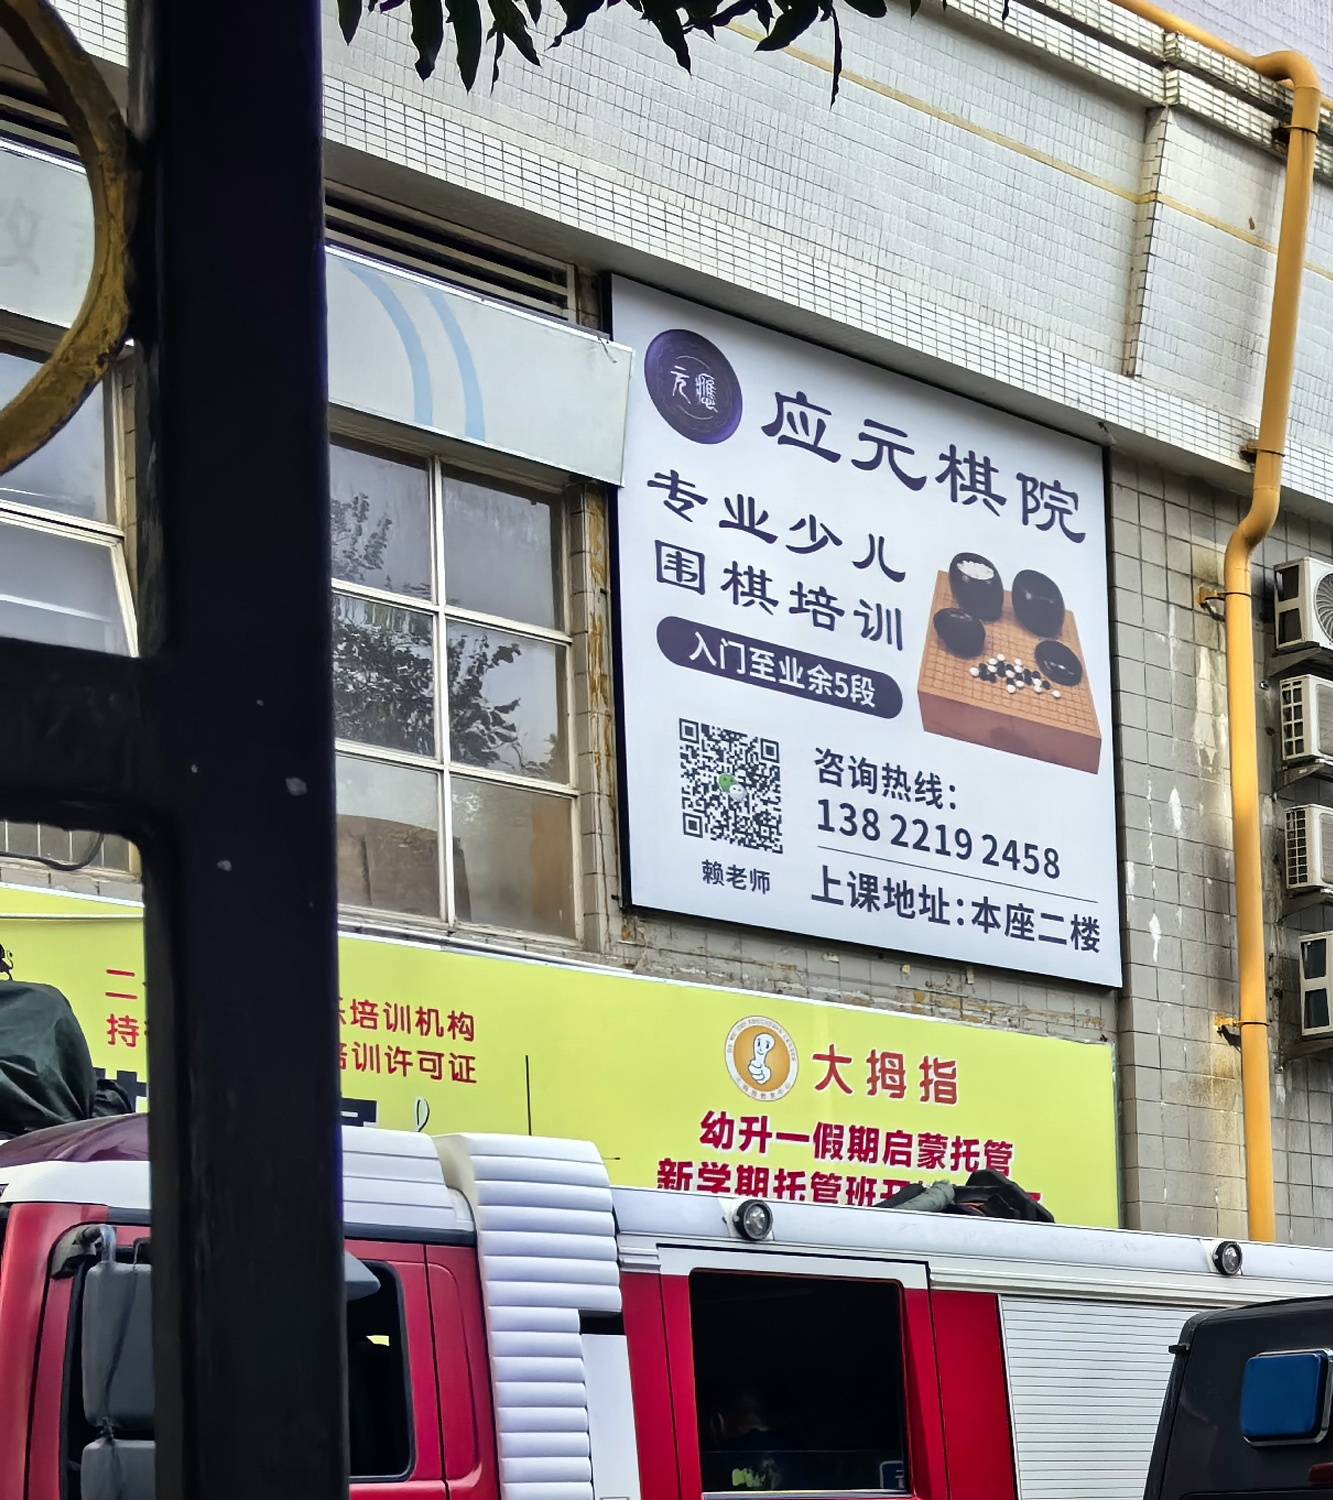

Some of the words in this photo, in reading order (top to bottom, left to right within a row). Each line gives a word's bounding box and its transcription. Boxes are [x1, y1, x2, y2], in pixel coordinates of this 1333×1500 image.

[761, 391, 1086, 543] 应元棋院
[646, 470, 907, 583] 专业少儿
[654, 540, 904, 651] 围棋培训
[689, 632, 877, 710] 入门至业余5段
[701, 860, 772, 895] 赖老师
[815, 799, 882, 842] 138
[889, 812, 973, 861] 2219
[981, 833, 1061, 880] 2458
[338, 997, 475, 1042] 培训机构
[812, 1044, 959, 1105] 大拇指
[700, 1111, 1014, 1175] 幼升一假期启蒙托管
